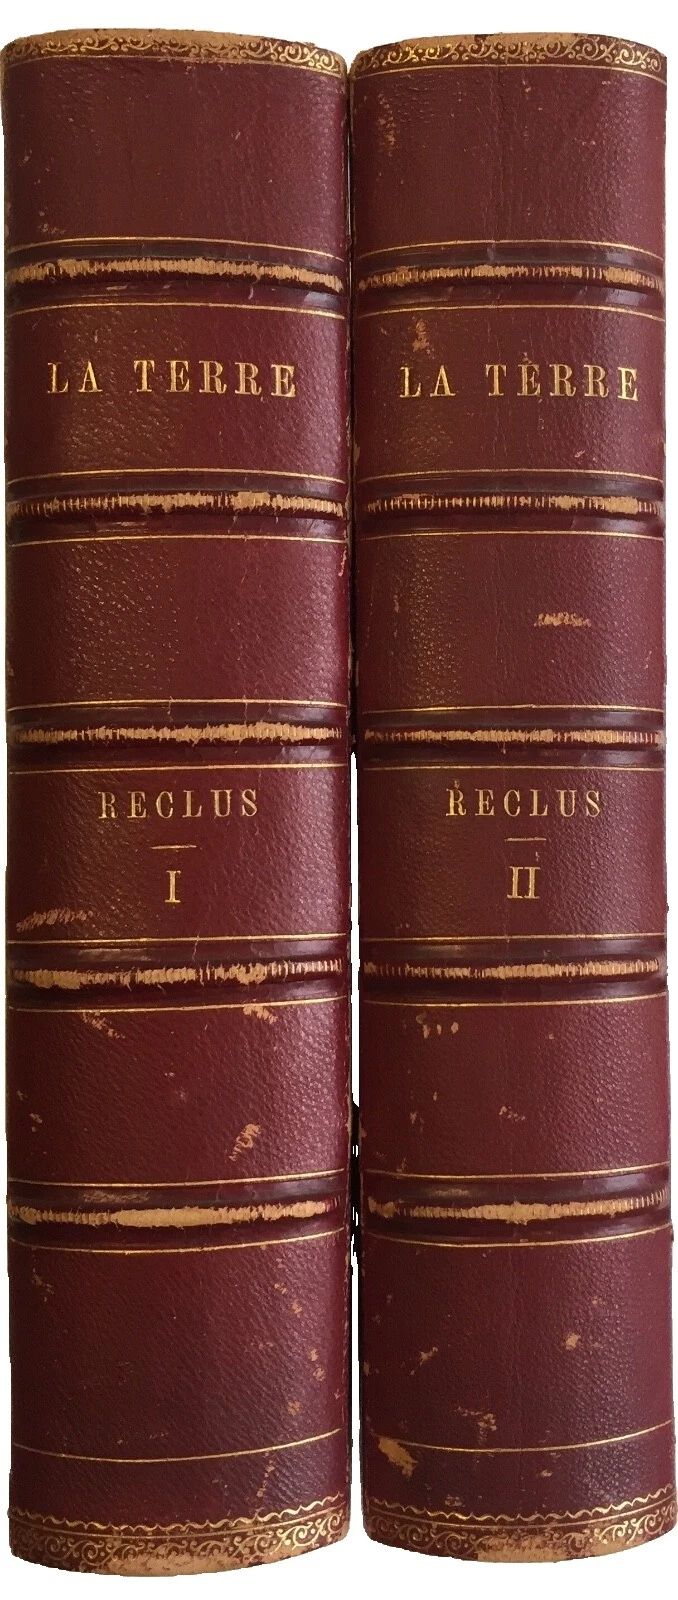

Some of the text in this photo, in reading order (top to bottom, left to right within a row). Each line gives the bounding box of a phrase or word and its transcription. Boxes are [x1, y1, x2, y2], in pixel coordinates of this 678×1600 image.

[47, 359, 297, 398] LA TERRE
[399, 363, 640, 402] LA TERRE
[98, 788, 260, 819] RECLUS
[445, 788, 602, 817] RECLUS
[164, 869, 182, 904] I
[506, 865, 541, 900] II
